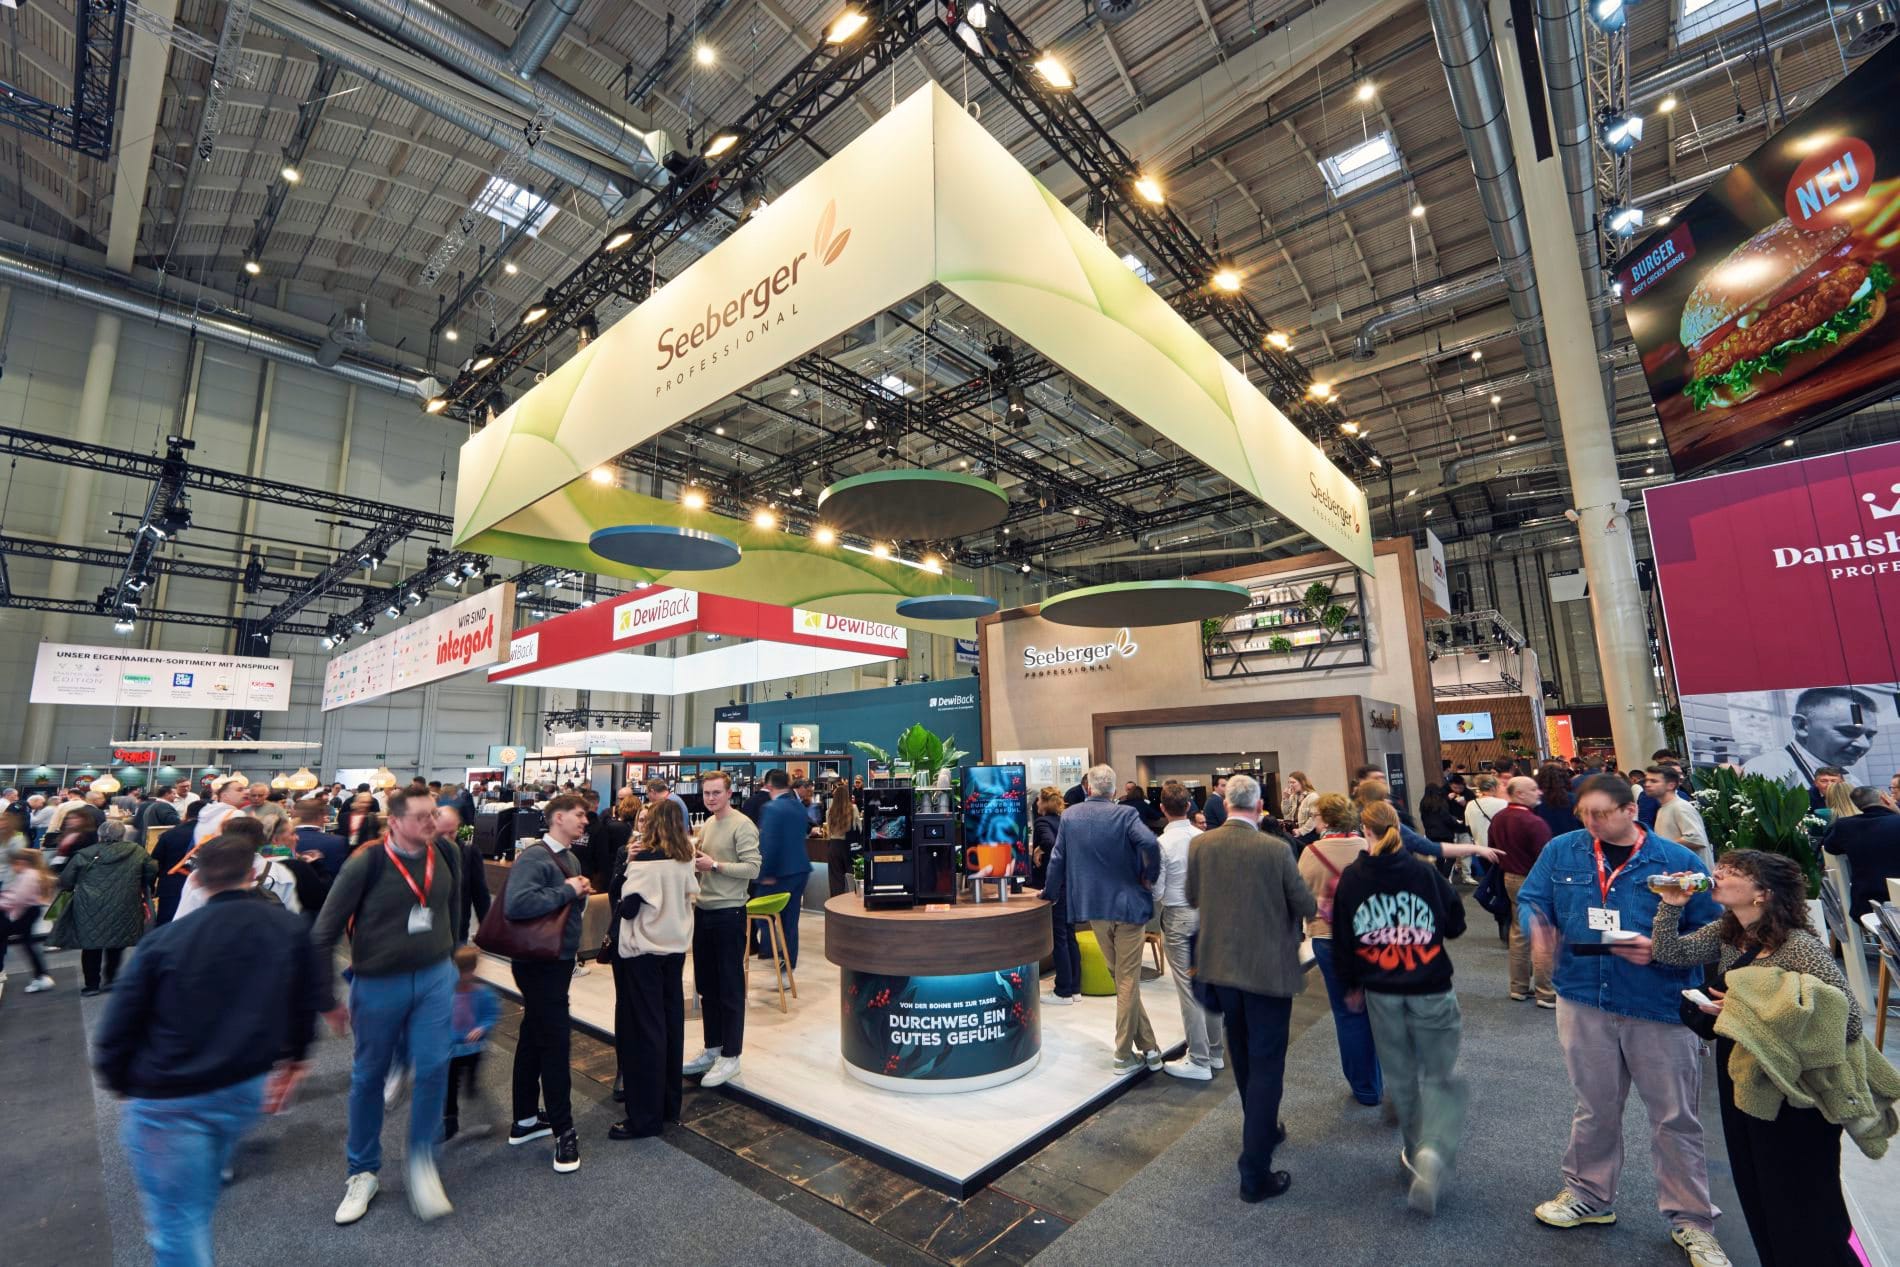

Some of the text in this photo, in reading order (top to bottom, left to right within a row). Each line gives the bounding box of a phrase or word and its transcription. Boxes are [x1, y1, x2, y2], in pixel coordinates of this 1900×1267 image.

[1795, 151, 1860, 220] NEU
[1631, 239, 1676, 283] BURGER
[1646, 266, 1667, 285] CHICKEN
[1665, 252, 1686, 271] BURGER
[656, 252, 807, 370] Seeberger
[656, 303, 798, 397] PROFESSIONAL
[1309, 471, 1352, 526] Seeberger
[1772, 531, 1900, 568] Danish
[1831, 560, 1900, 580] PROFE
[458, 607, 487, 629] WIR SIND
[633, 592, 691, 627] DewiBack
[825, 613, 899, 640] DewiBack
[436, 614, 494, 665] intergast
[510, 639, 534, 661] wiBack
[57, 651, 91, 659] UNSER
[93, 653, 216, 667] EIGENMARKEN-SORTIMENT
[236, 663, 280, 671] ANSPRUCH
[1024, 643, 1113, 667] Seeberger
[1024, 663, 1113, 680] PROFESSIONAL
[938, 693, 975, 707] DewiBack
[1360, 927, 1433, 946] CREW
[979, 997, 997, 1006] TASSE
[889, 1008, 1006, 1030] DURCHWEG EIN
[890, 1024, 1006, 1046] GUTES GEFÜHL
